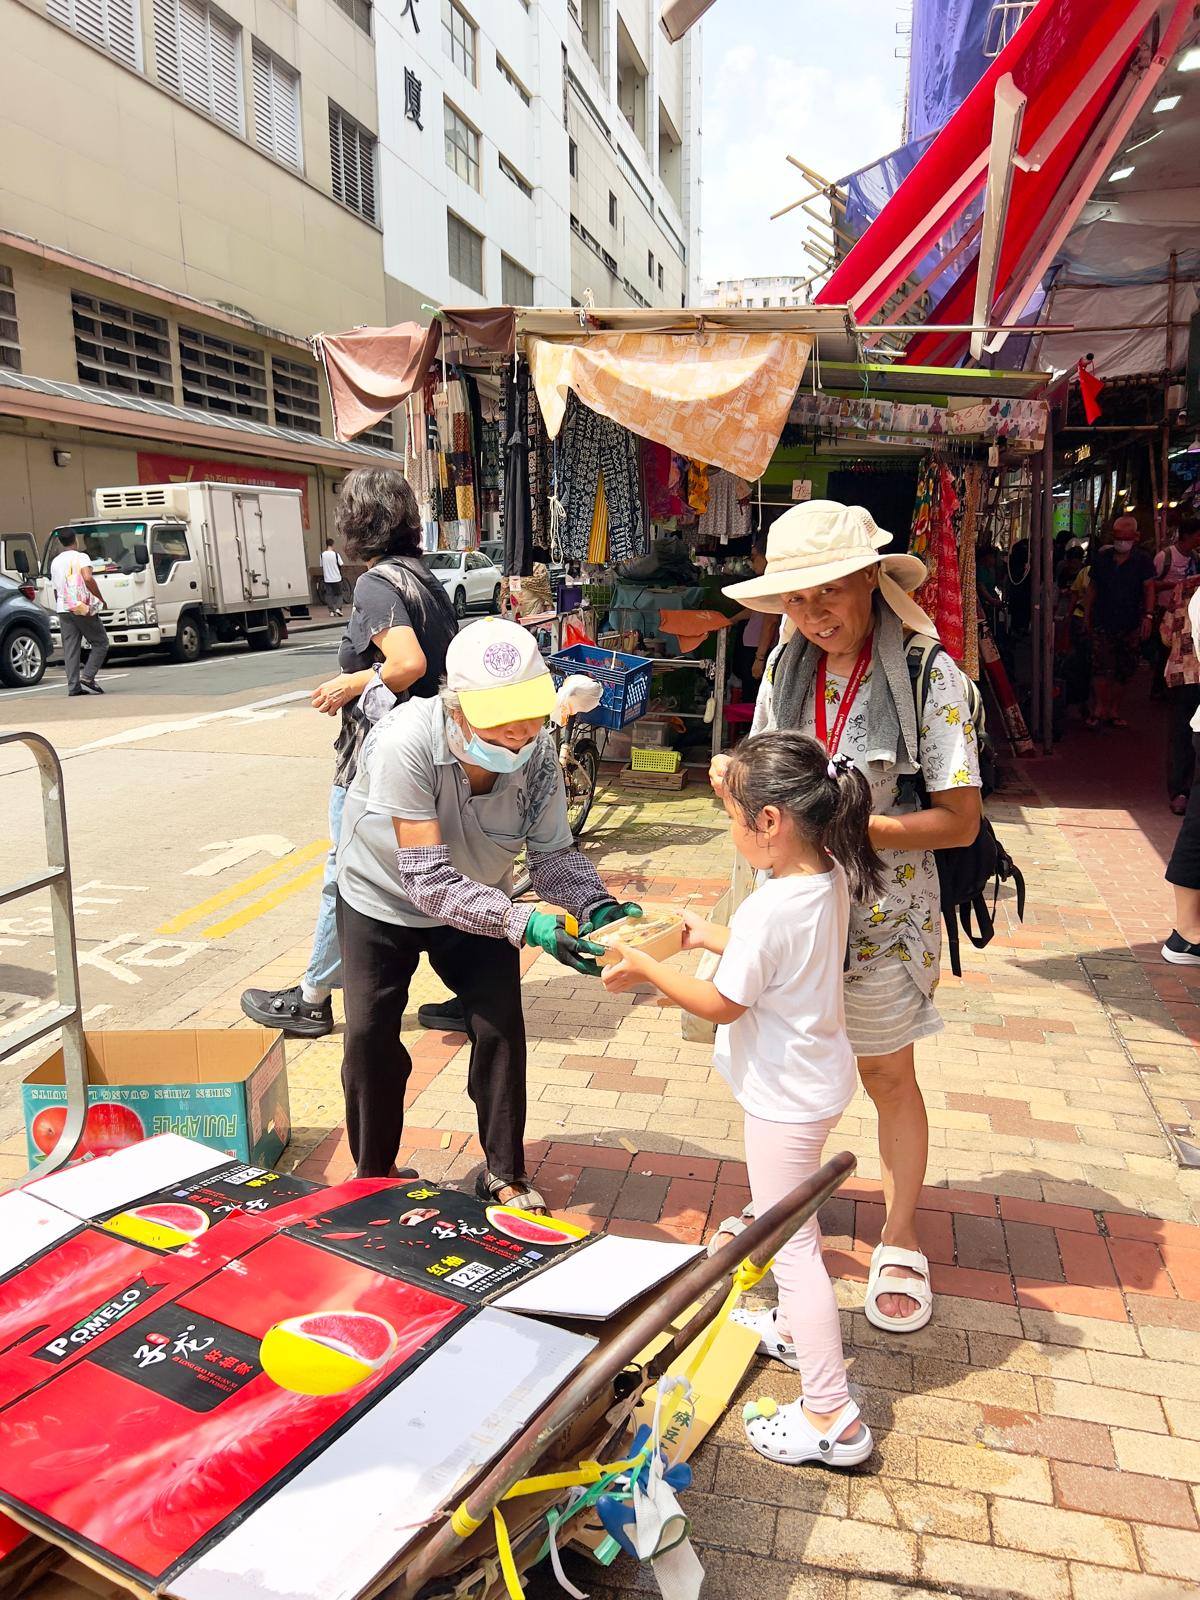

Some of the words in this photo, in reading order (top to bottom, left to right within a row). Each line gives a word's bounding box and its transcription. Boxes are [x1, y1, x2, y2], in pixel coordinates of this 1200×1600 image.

[101, 1088, 149, 1100] GUANG
[154, 1087, 191, 1099] ZHEN
[196, 1087, 232, 1099] SHEN
[152, 1114, 201, 1138] APPLE
[204, 1114, 238, 1138] FUJI
[425, 1255, 466, 1277] 红柚
[45, 1289, 141, 1357] POMELO
